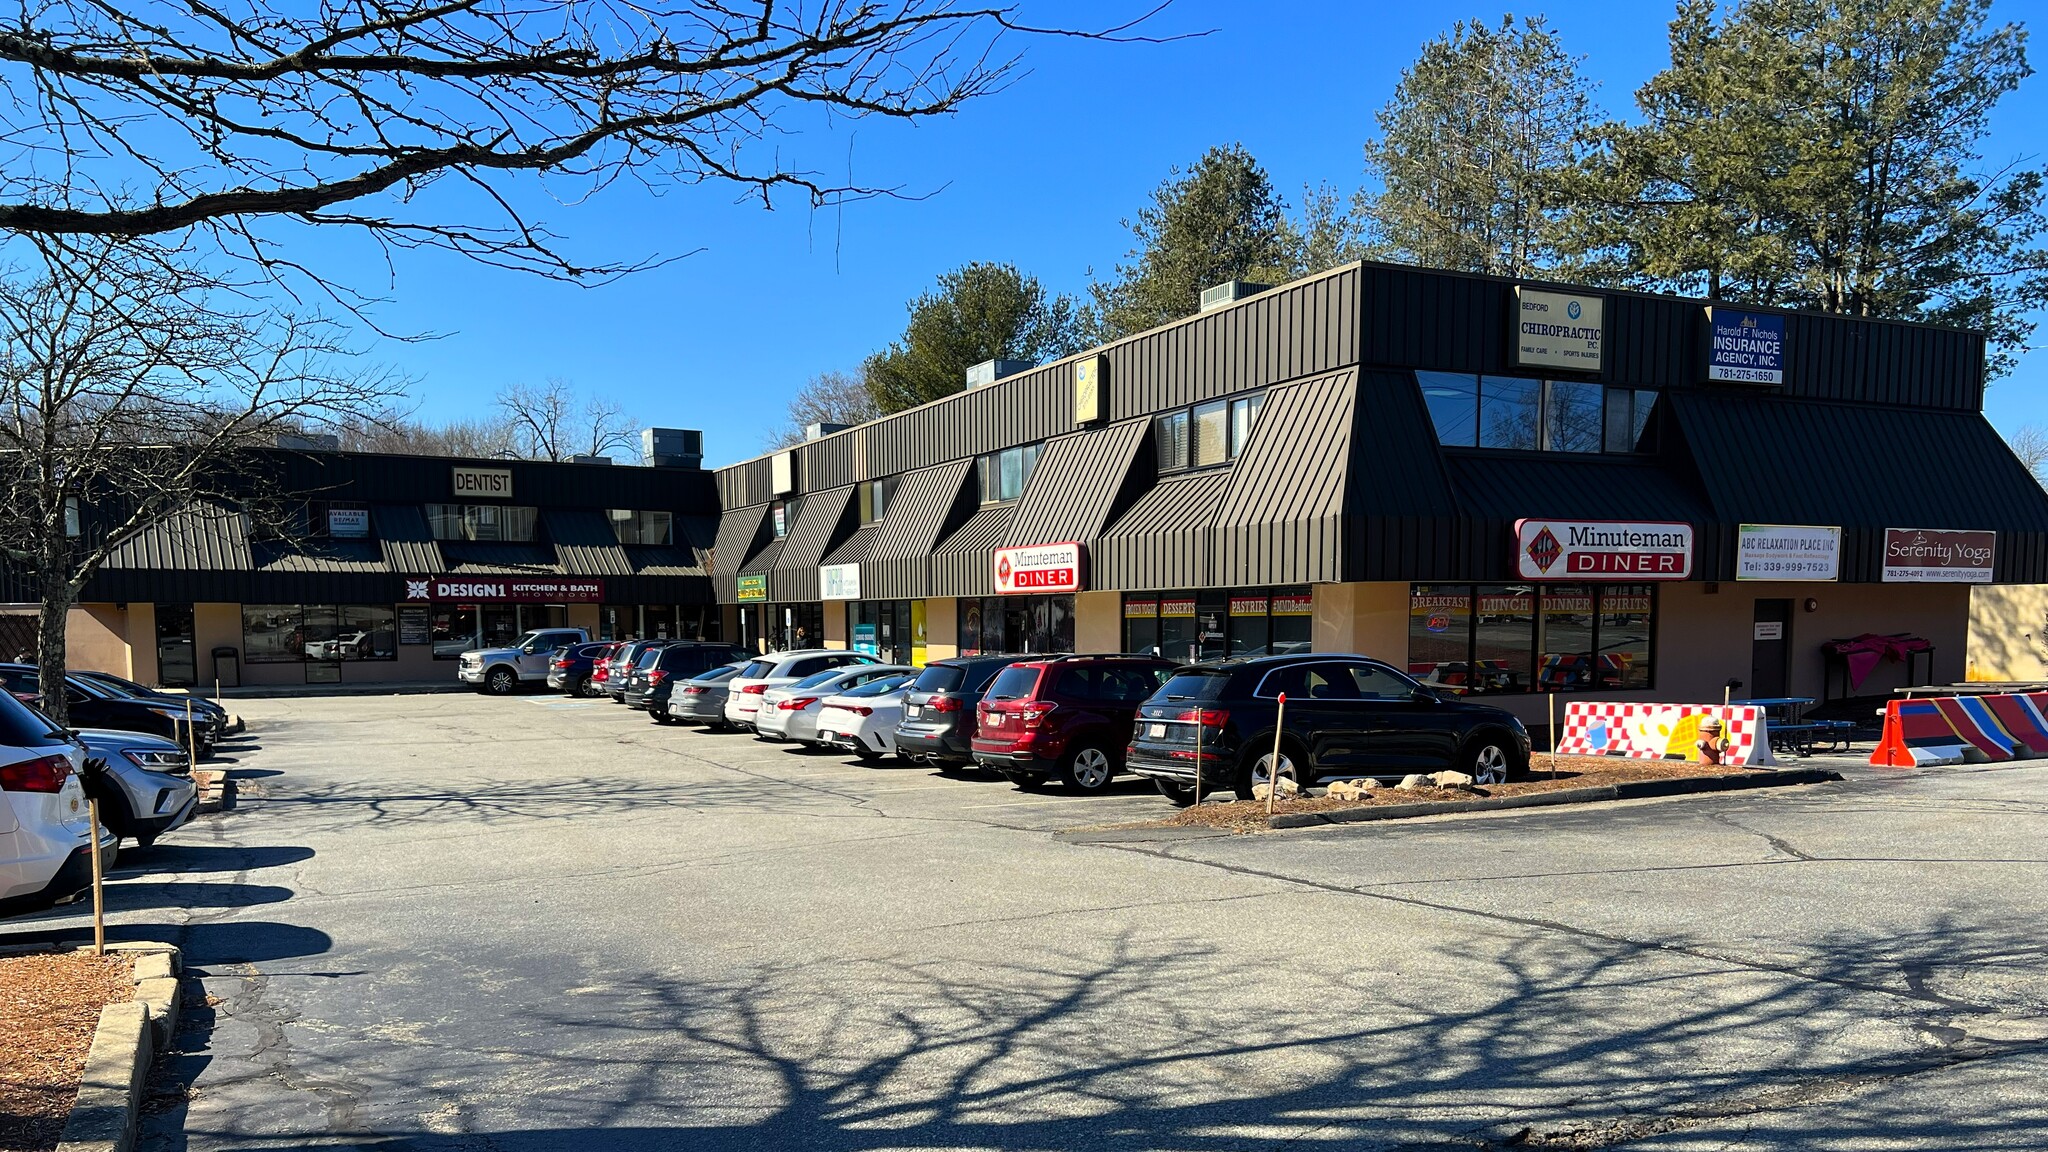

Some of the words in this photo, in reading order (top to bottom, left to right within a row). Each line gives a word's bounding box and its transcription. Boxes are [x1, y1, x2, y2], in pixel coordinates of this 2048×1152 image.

[1522, 302, 1548, 312] BEDFORD
[1521, 322, 1600, 340] CHIROPRACTIC
[1717, 325, 1741, 337] Harold
[1743, 328, 1750, 337] F.
[1752, 329, 1778, 340] Nichols
[1714, 336, 1780, 354] INSURANCE
[1716, 352, 1757, 367] AGENCY,
[1759, 355, 1777, 366] INC.
[1719, 368, 1774, 381] 781-275-1650
[456, 474, 509, 491] DENTIST
[1569, 526, 1685, 547] Minuteman
[1742, 538, 1755, 549] ABC
[1758, 538, 1798, 550] RELAXATION
[1800, 539, 1820, 550] PLACE
[1015, 551, 1073, 567] Minuteman
[1888, 541, 1952, 566] Serenity
[1956, 544, 1991, 566] Yoga
[1579, 555, 1674, 571] DINER
[1744, 562, 1761, 571] Tel:
[1764, 562, 1829, 572] 339-999-7523
[1018, 570, 1068, 585] DINER
[1926, 570, 1990, 579] www.serenityyoga.com
[438, 584, 506, 597] DESIGN1
[512, 584, 558, 592] KITCHEN
[1163, 602, 1195, 614] DESSERTS
[1232, 601, 1267, 613] PASTRIES
[1412, 597, 1470, 609] BREAKFAST
[1482, 599, 1530, 612] LUNCH
[1542, 598, 1591, 611] DINNER
[1603, 598, 1648, 610] SPIRITS
[1426, 617, 1449, 628] OPEN
